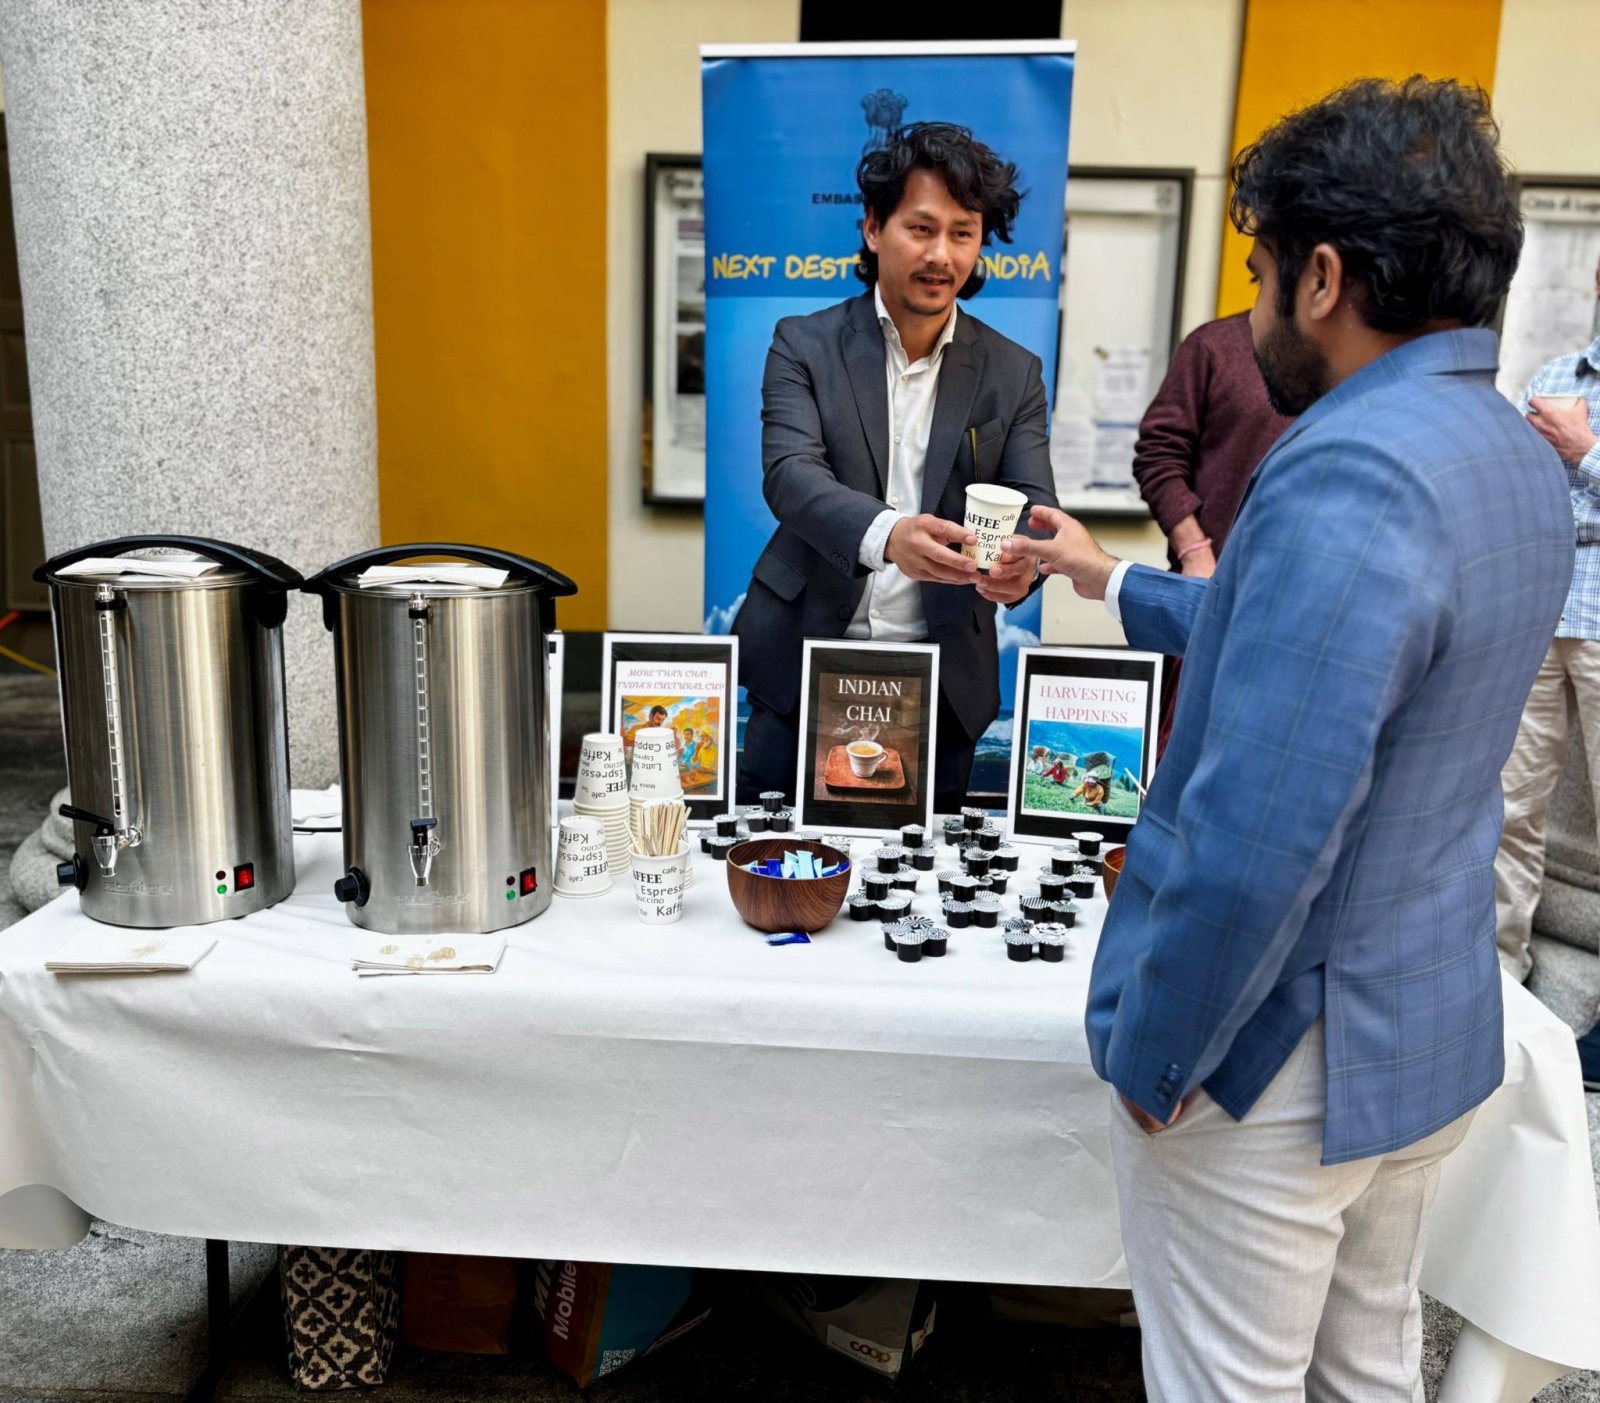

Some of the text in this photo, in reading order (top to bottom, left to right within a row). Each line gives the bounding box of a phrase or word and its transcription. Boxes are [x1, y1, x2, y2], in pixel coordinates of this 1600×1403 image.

[812, 192, 862, 205] EMBAS
[712, 252, 777, 280] NEXT
[784, 254, 861, 281] DEST
[965, 511, 1001, 530] AFFEE
[838, 678, 902, 697] INDIAN
[1040, 685, 1136, 703] HARVESTING
[846, 705, 891, 722] CHAI
[1045, 706, 1128, 724] HAPPINESS
[582, 748, 610, 762] Kaffe
[559, 830, 588, 844] Kaffe
[553, 1261, 577, 1340] Mobile
[849, 1340, 892, 1364] coop
